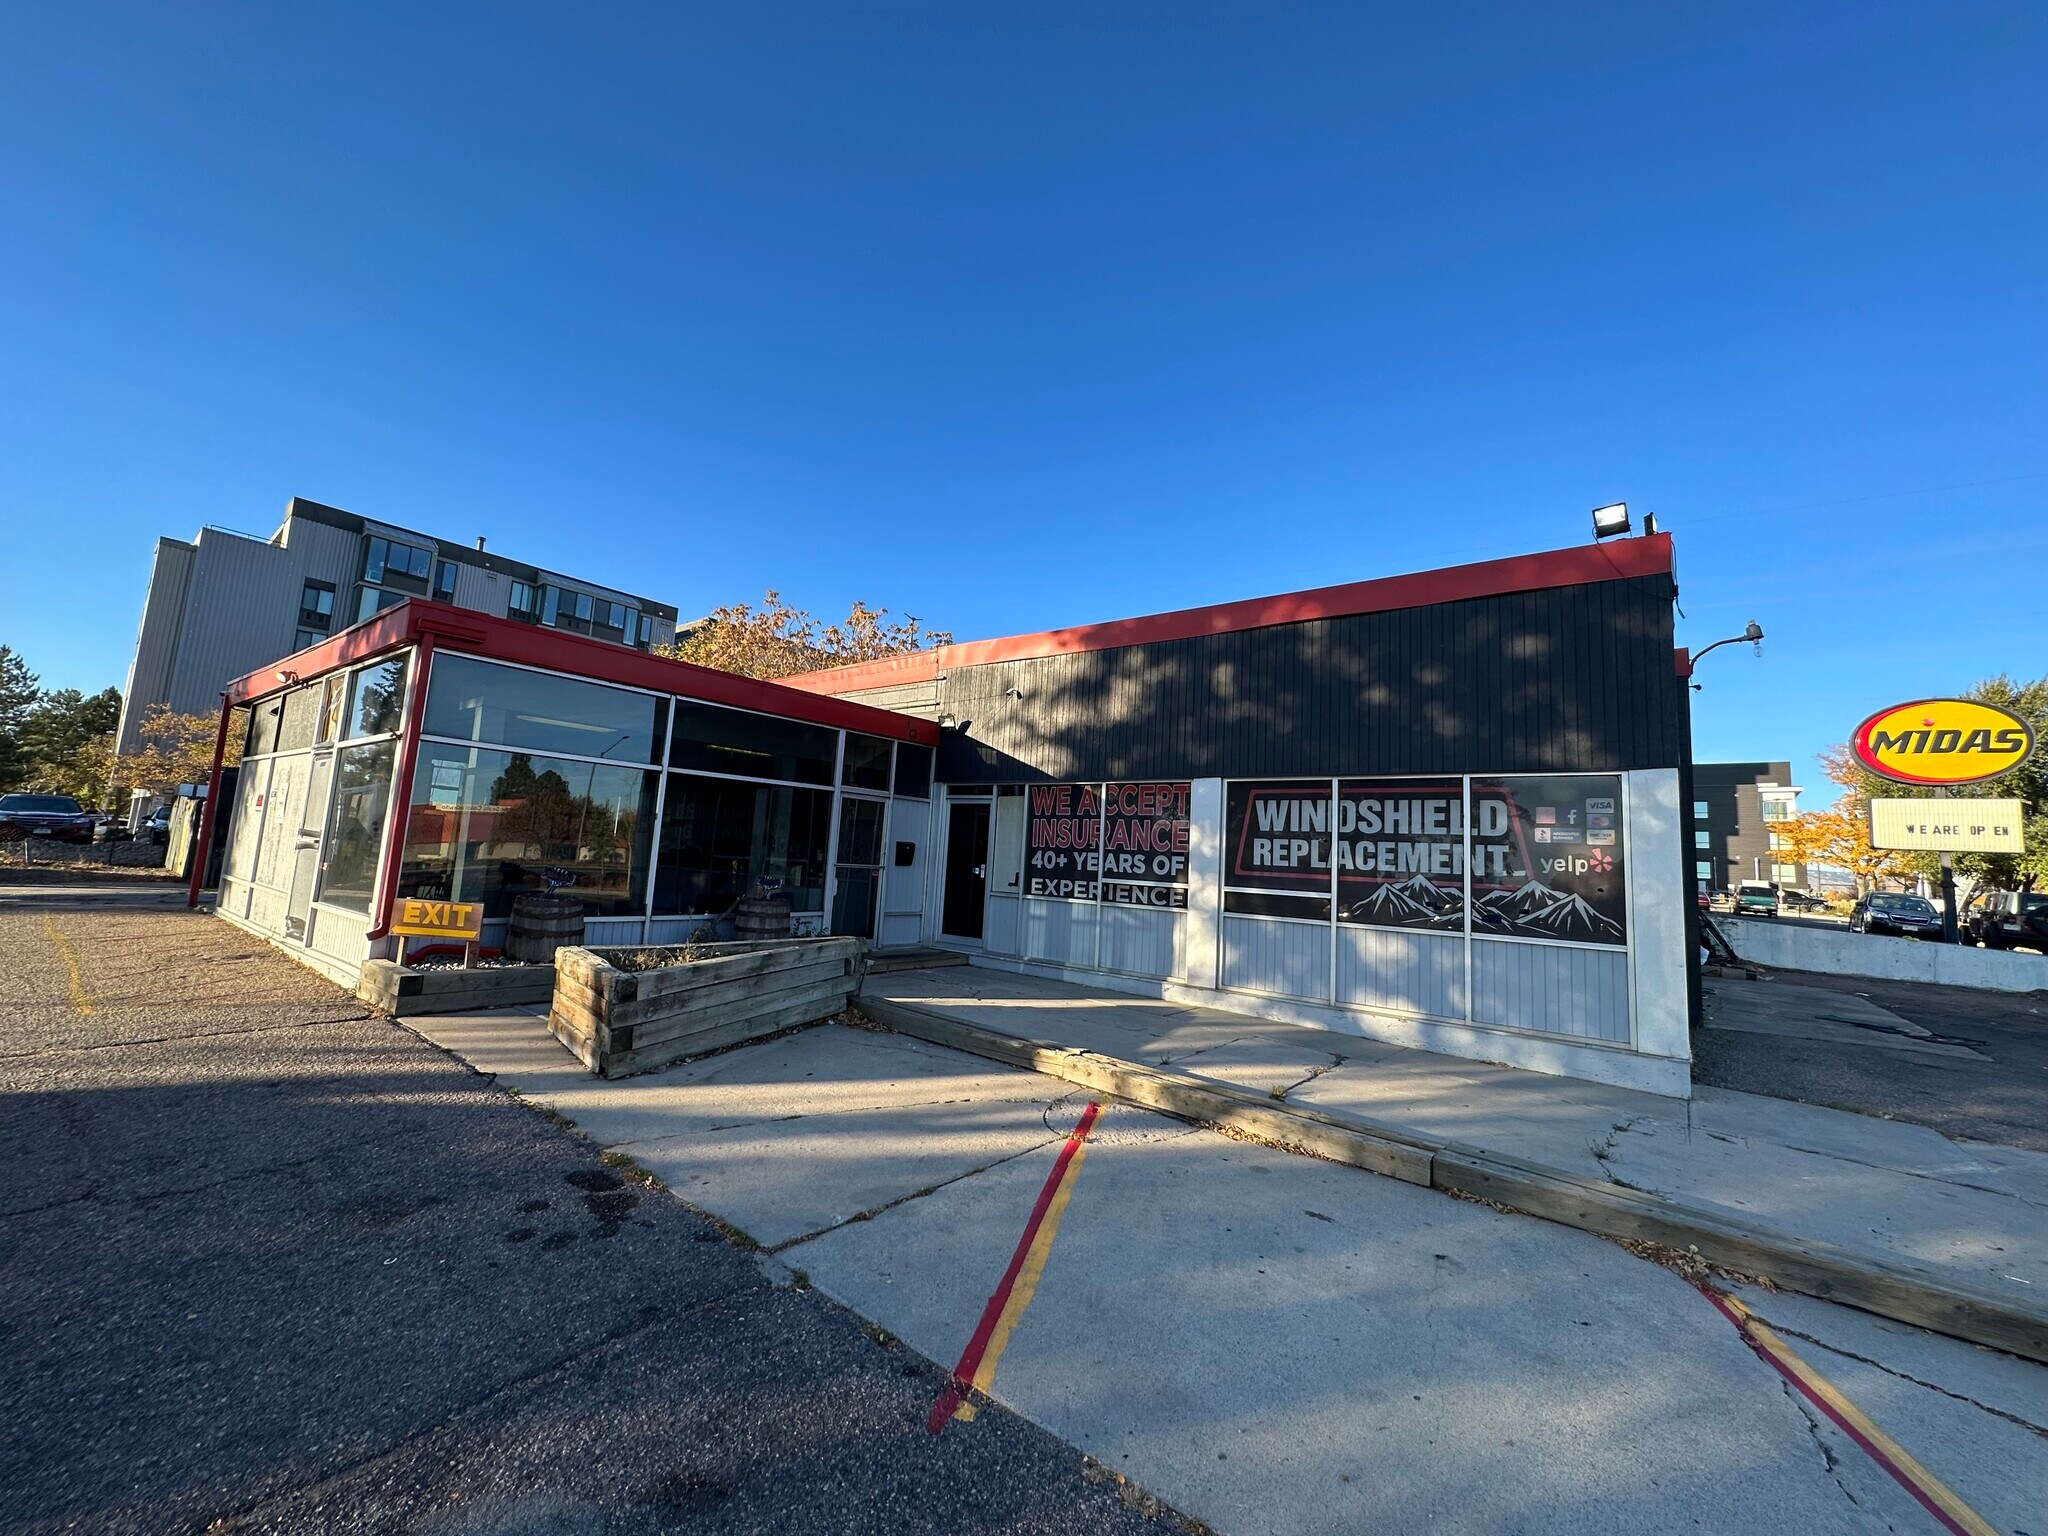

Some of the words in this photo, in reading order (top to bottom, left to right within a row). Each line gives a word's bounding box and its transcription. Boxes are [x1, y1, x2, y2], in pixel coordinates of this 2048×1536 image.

[1870, 718, 2025, 757] MIDAS
[1032, 786, 1071, 816] WE
[1077, 784, 1190, 817] ACCEPT
[1255, 799, 1508, 836] WINDSHIELD
[1906, 824, 1927, 834] WE
[1932, 825, 1959, 835] ARE
[1032, 818, 1189, 852] INSURANCE
[1031, 851, 1067, 869] 40+
[1073, 852, 1146, 874] YEARS
[1152, 855, 1185, 876] OF
[1253, 838, 1509, 877] REPLACEMENT
[1540, 855, 1588, 876] yelp
[1031, 878, 1184, 907] EXPERIENCE
[403, 901, 473, 927] EXIT
